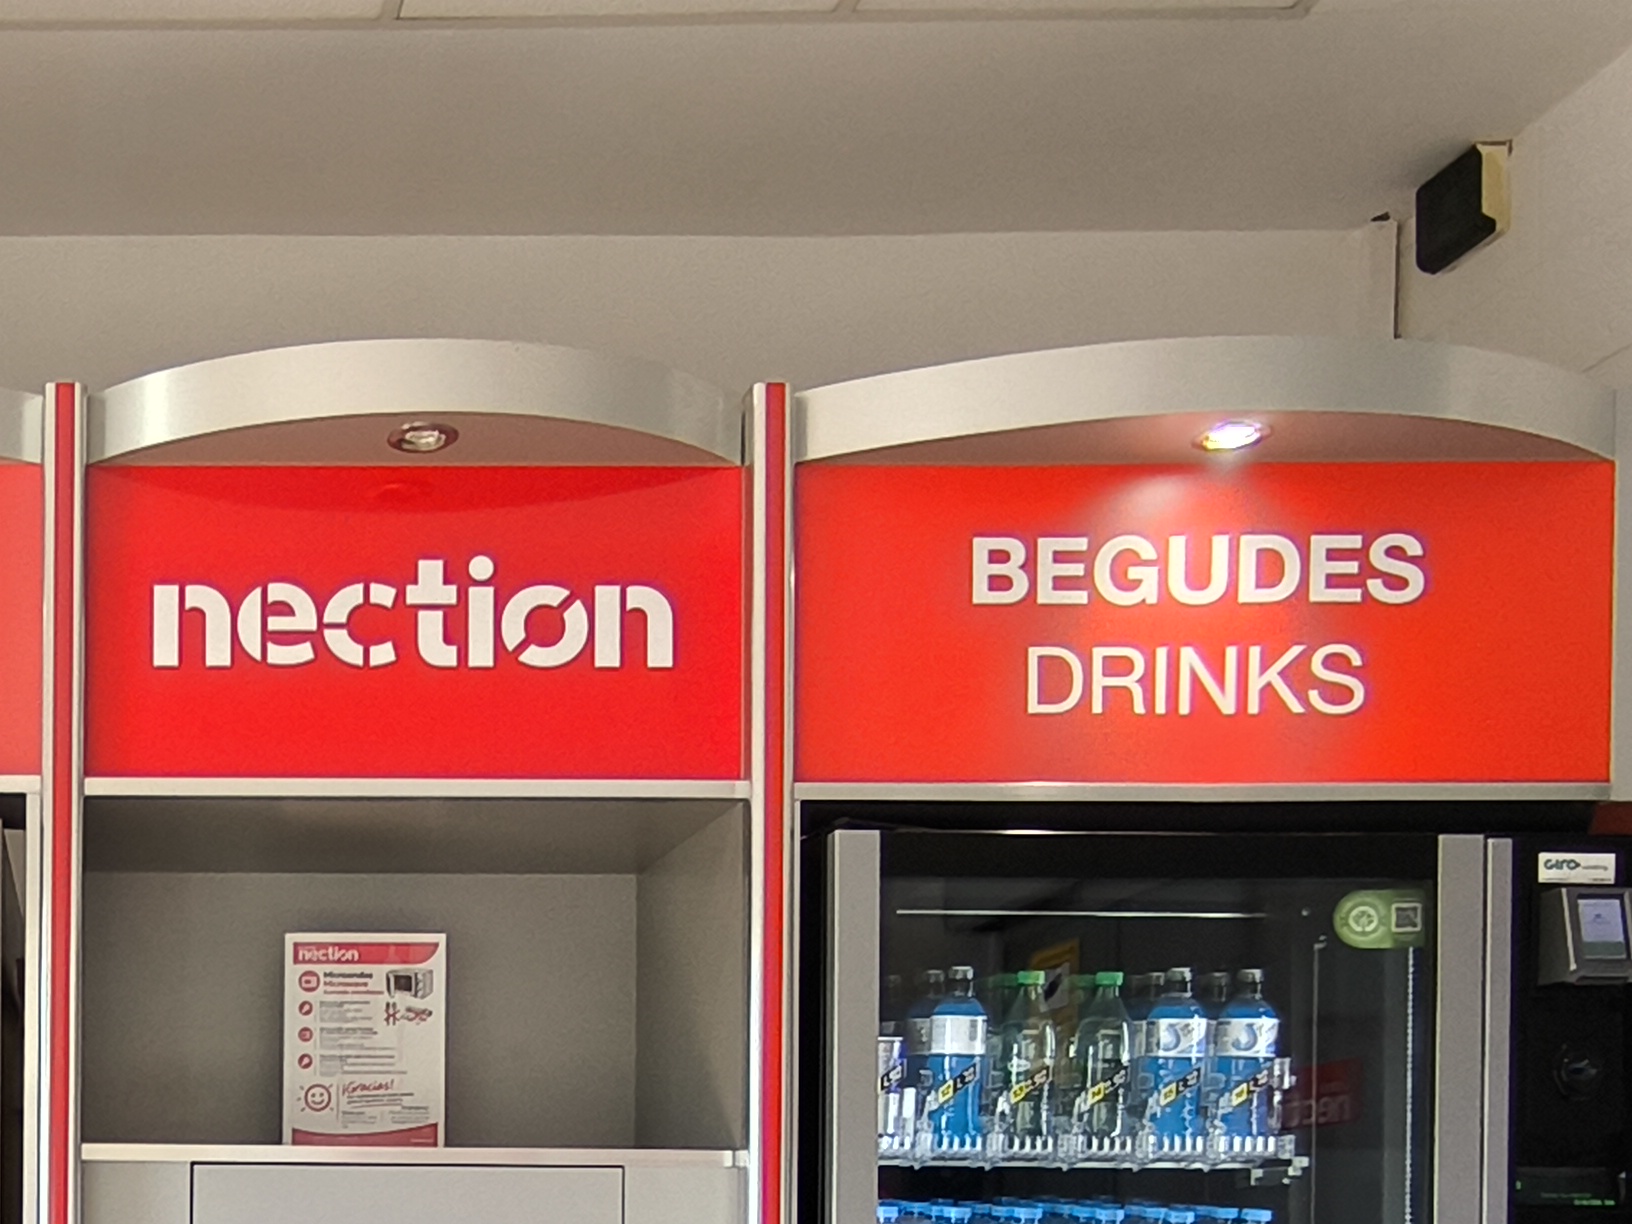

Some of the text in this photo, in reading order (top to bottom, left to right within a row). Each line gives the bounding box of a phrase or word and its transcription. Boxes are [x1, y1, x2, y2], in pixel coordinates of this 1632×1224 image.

[971, 534, 1426, 606] BEGUDES
[153, 555, 673, 668] nection
[1026, 643, 1366, 715] DRINKS
